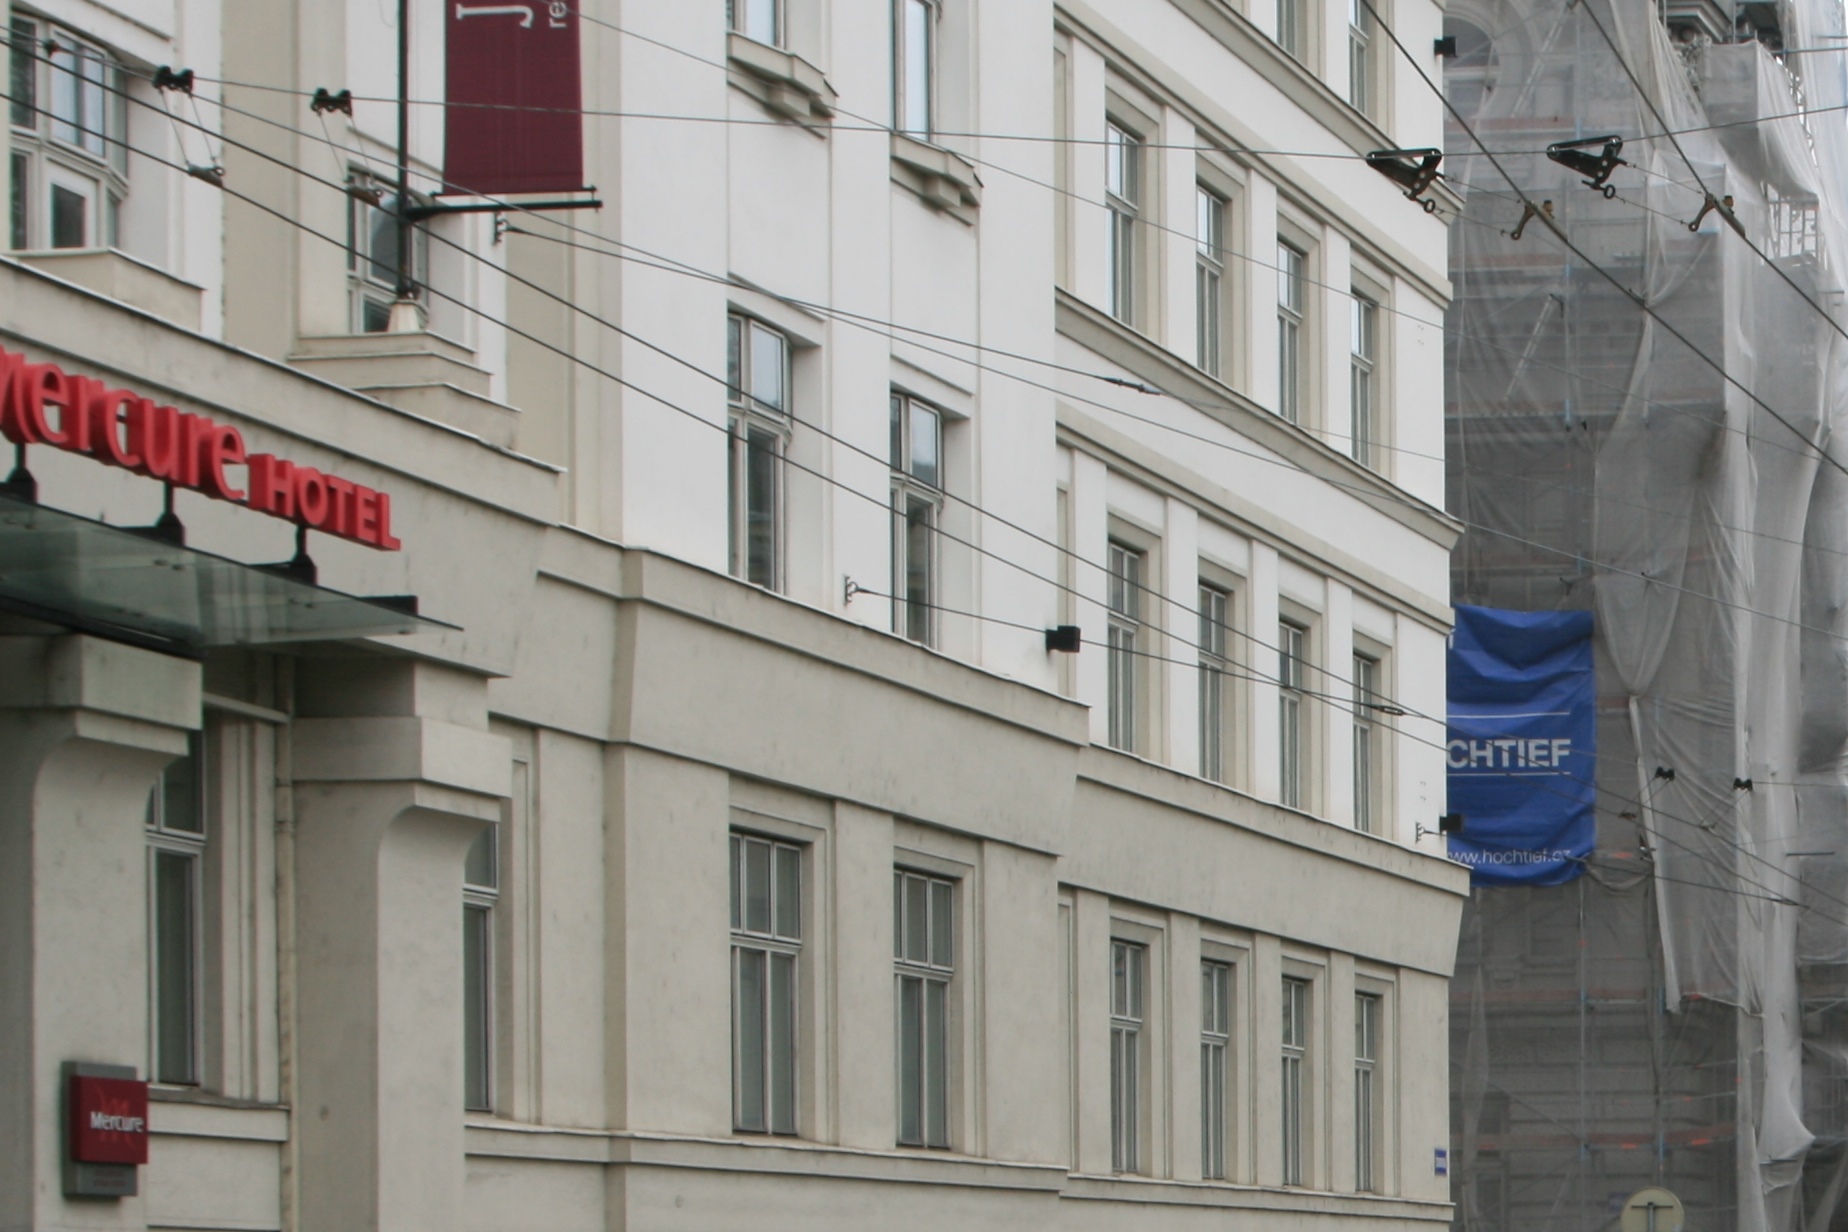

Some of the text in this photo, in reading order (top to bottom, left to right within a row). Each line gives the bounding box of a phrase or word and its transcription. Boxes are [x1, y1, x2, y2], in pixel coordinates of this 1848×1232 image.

[249, 452, 402, 552] HOTEL
[1447, 848, 1572, 865] ww.hochtief.cz
[90, 1111, 145, 1133] Mercure
